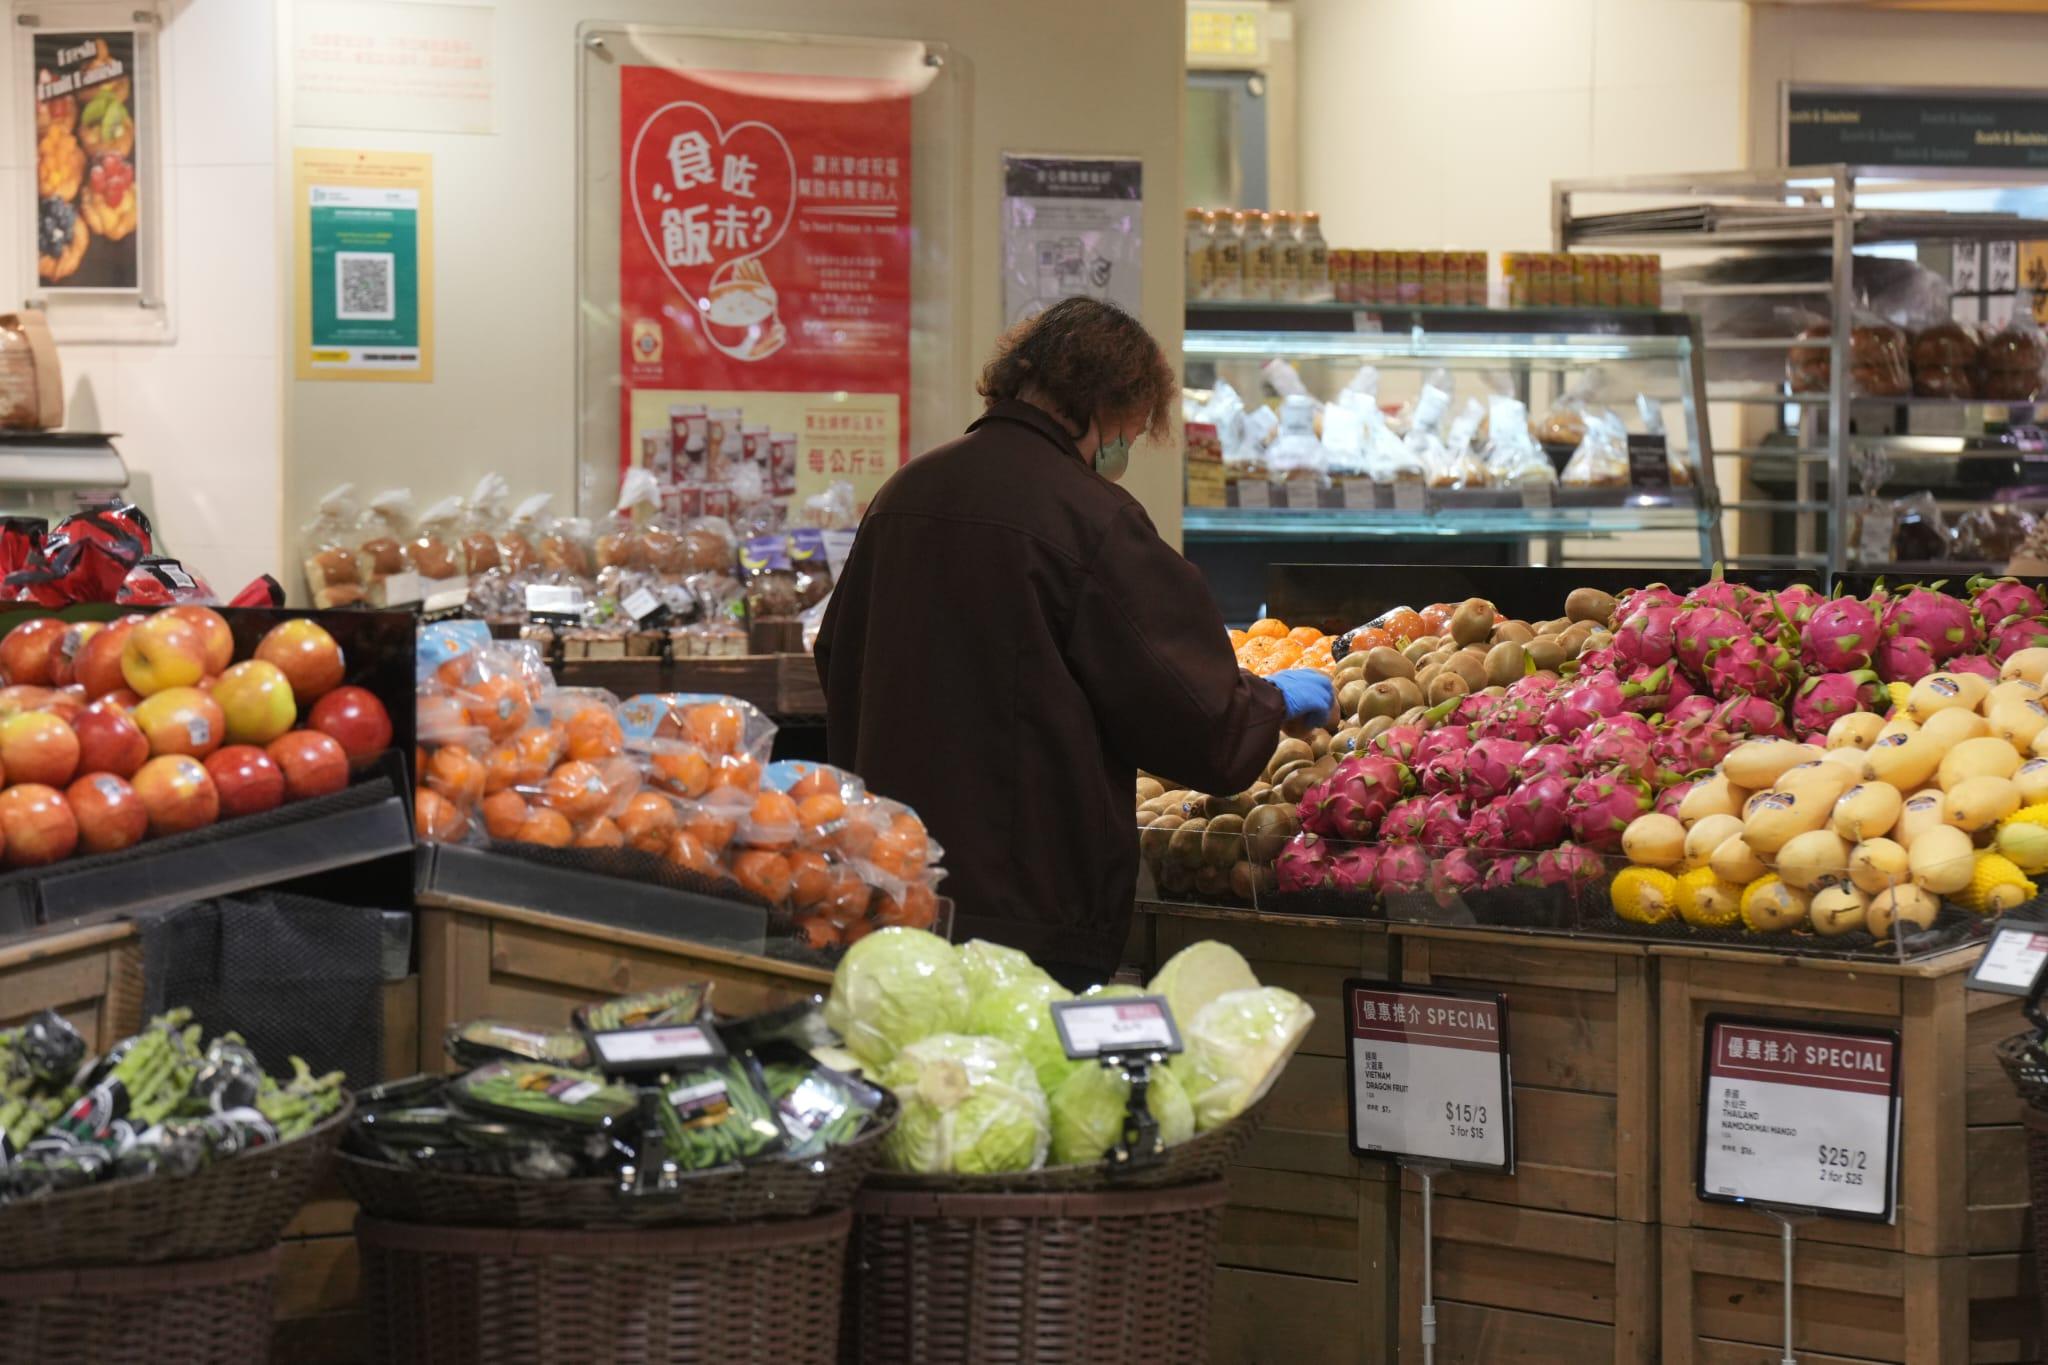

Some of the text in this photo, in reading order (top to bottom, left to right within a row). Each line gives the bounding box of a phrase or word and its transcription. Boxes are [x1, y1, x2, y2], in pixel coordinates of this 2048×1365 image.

[666, 130, 758, 198] 食咗
[661, 203, 773, 267] 飯未?
[1363, 1000, 1496, 1031] 優惠推介 SPECIAL
[1727, 1036, 1887, 1073] 優惠推介 SPECIAL
[1365, 1071, 1391, 1081] VIETNAM
[1366, 1081, 1409, 1093] DRAGON FRUIT
[1446, 1101, 1487, 1125] $15/3
[1722, 1108, 1760, 1120] THAILAND
[1450, 1124, 1484, 1139] 3 for $15
[1818, 1144, 1868, 1171] $25/2
[1819, 1168, 1864, 1185] 2 for $25
